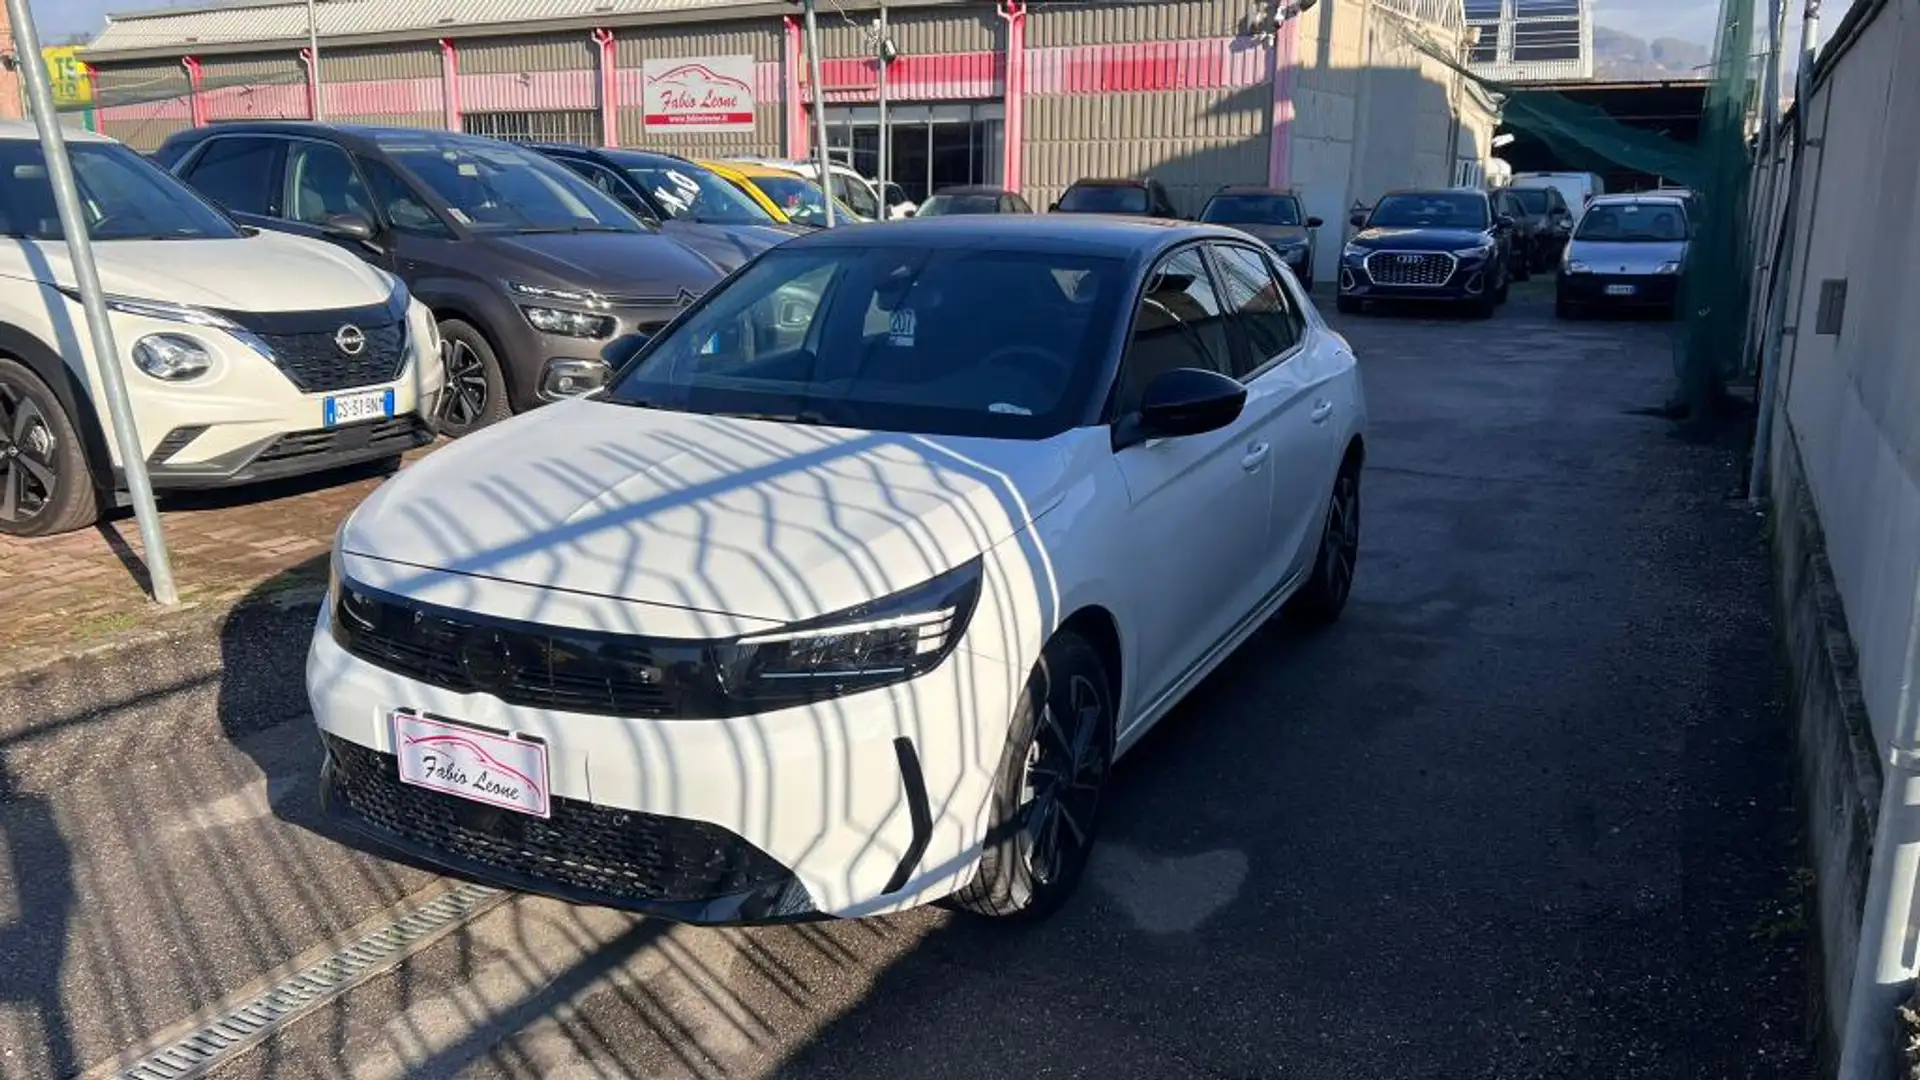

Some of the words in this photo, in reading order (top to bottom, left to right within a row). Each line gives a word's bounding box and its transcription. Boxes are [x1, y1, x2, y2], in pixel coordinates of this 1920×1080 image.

[660, 90, 696, 112] Fabio
[700, 89, 737, 108] Leone
[423, 756, 467, 787] Fabio
[472, 771, 519, 800] Leone
